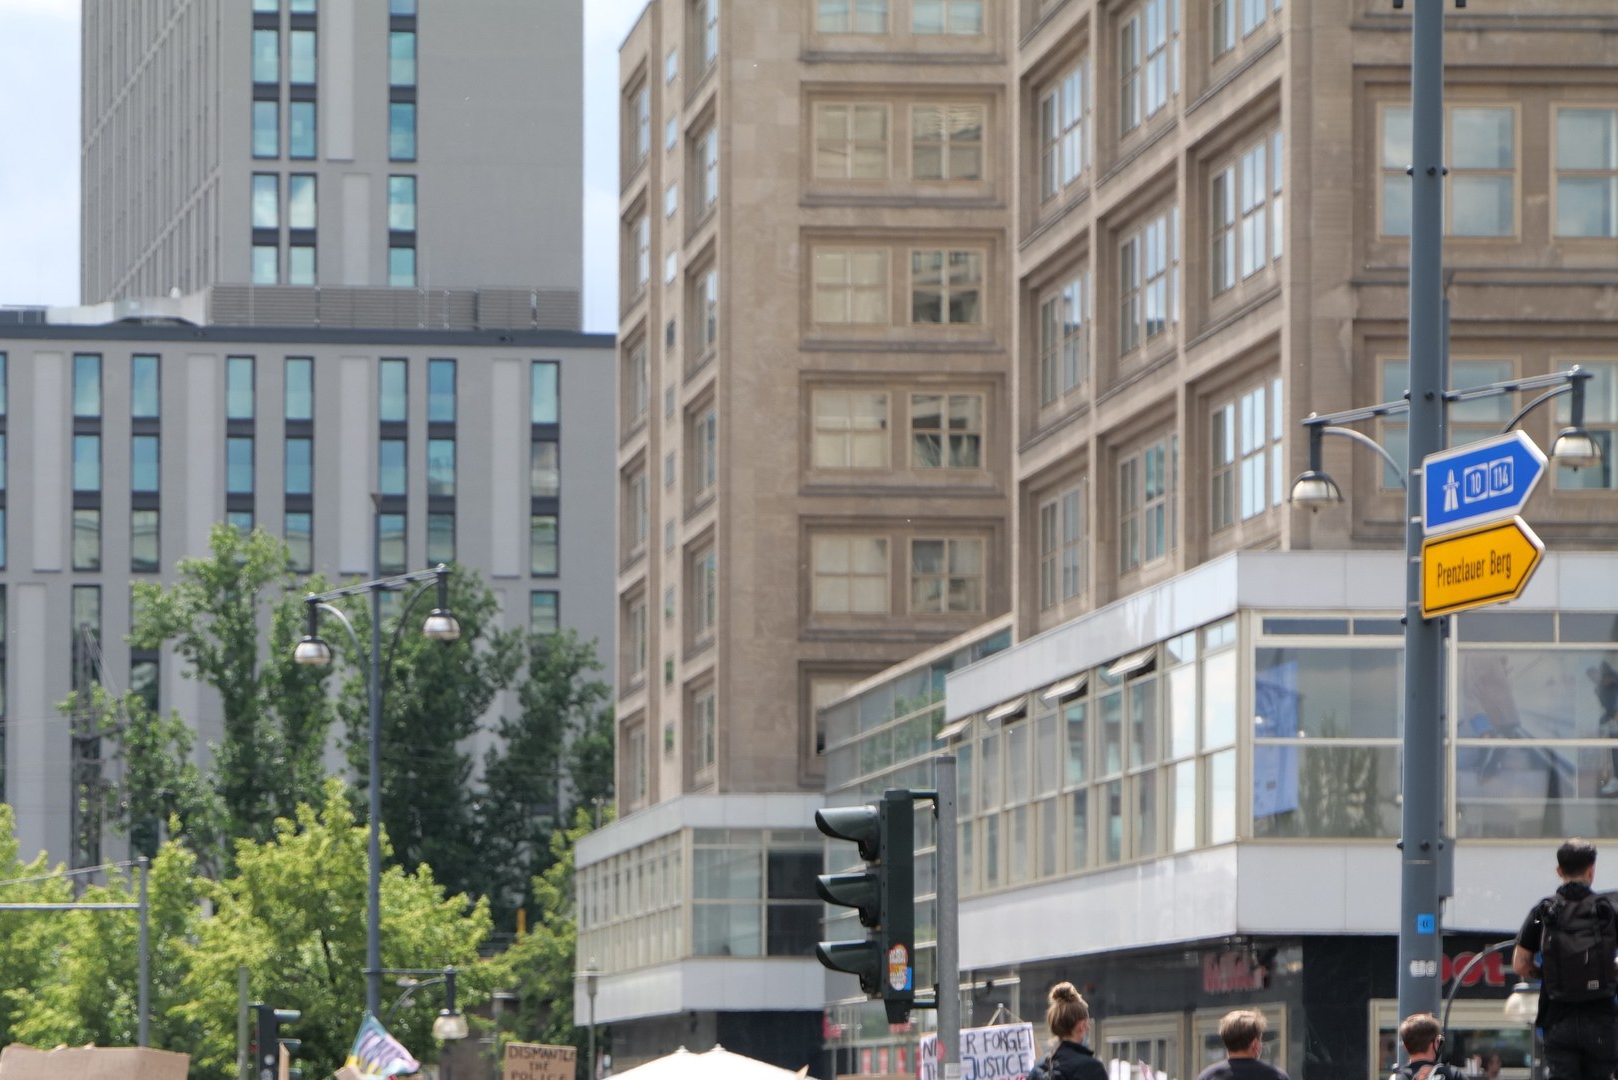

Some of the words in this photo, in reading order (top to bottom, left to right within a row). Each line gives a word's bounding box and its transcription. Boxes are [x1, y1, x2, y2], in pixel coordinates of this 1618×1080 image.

[1470, 472, 1481, 495] 10
[1493, 464, 1508, 489] 114
[1437, 557, 1486, 588] Prenzlauer
[1490, 549, 1512, 579] Berg
[983, 1027, 1032, 1053] FORGET
[529, 1062, 550, 1071] THE
